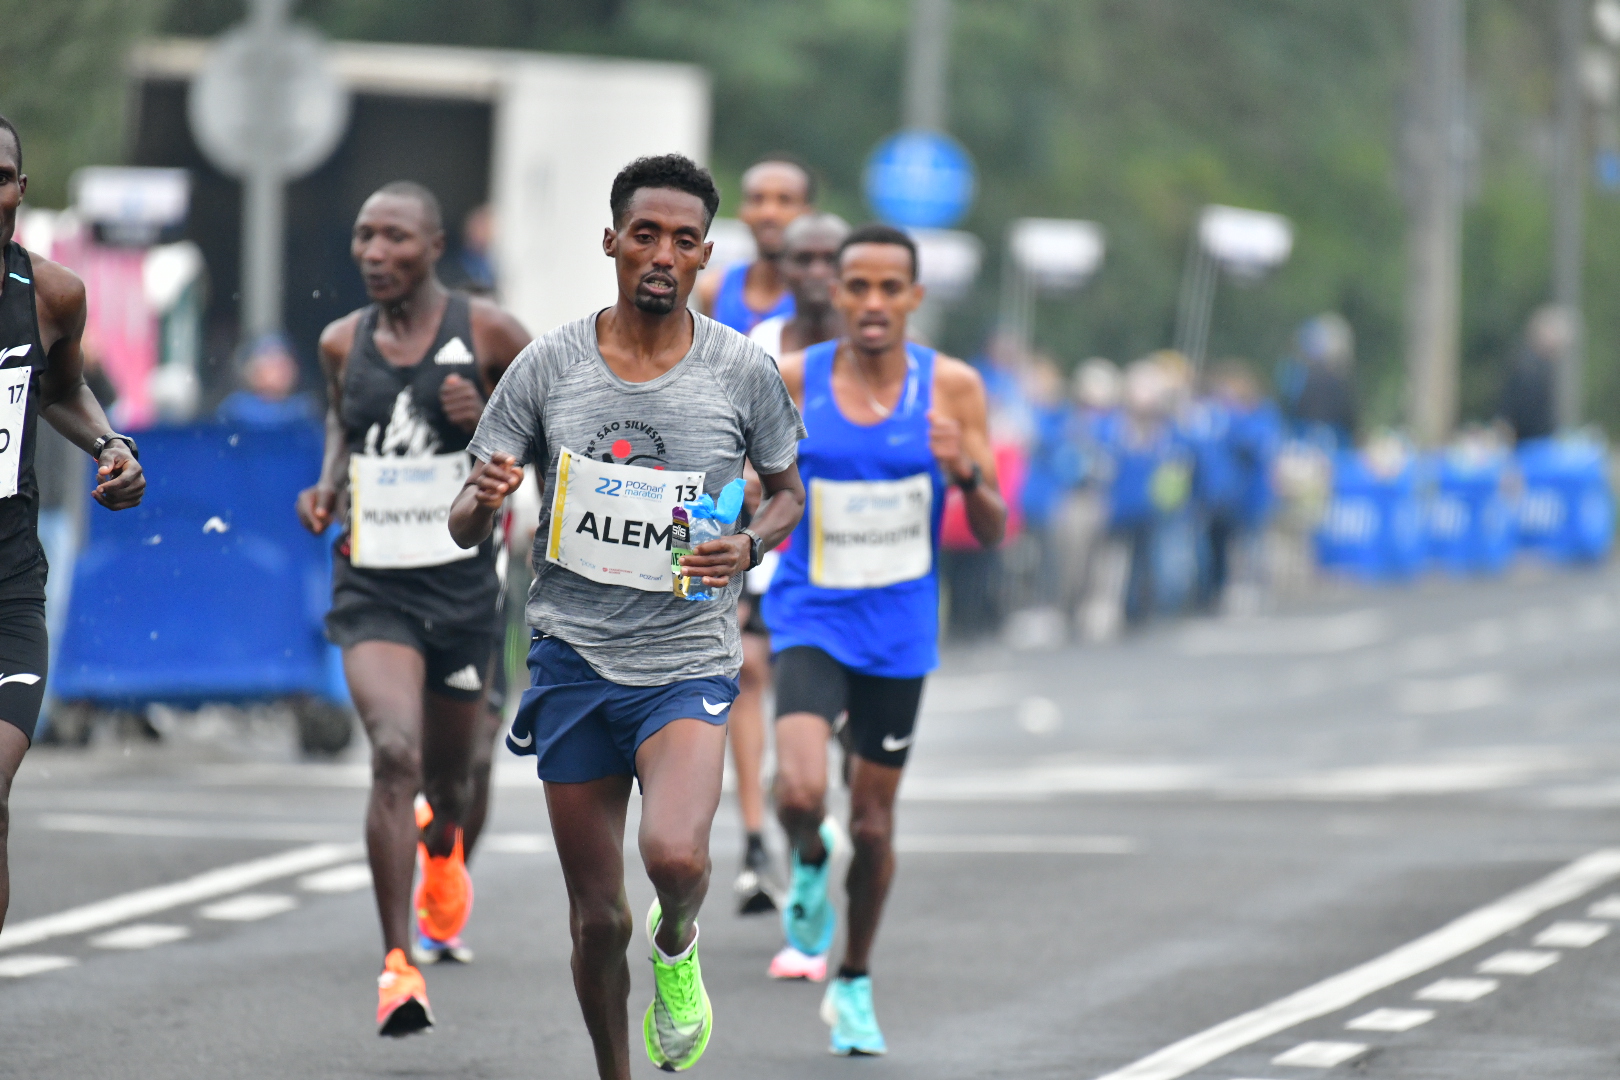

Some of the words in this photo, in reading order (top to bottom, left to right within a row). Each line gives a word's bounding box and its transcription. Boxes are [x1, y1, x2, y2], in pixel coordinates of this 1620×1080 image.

[8, 383, 25, 405] 17
[596, 421, 620, 440] SÃO
[624, 420, 667, 456] SILVESTRE
[594, 476, 623, 497] 22
[624, 488, 663, 500] maraton
[674, 484, 698, 503] 13
[575, 510, 673, 551] ALEM
